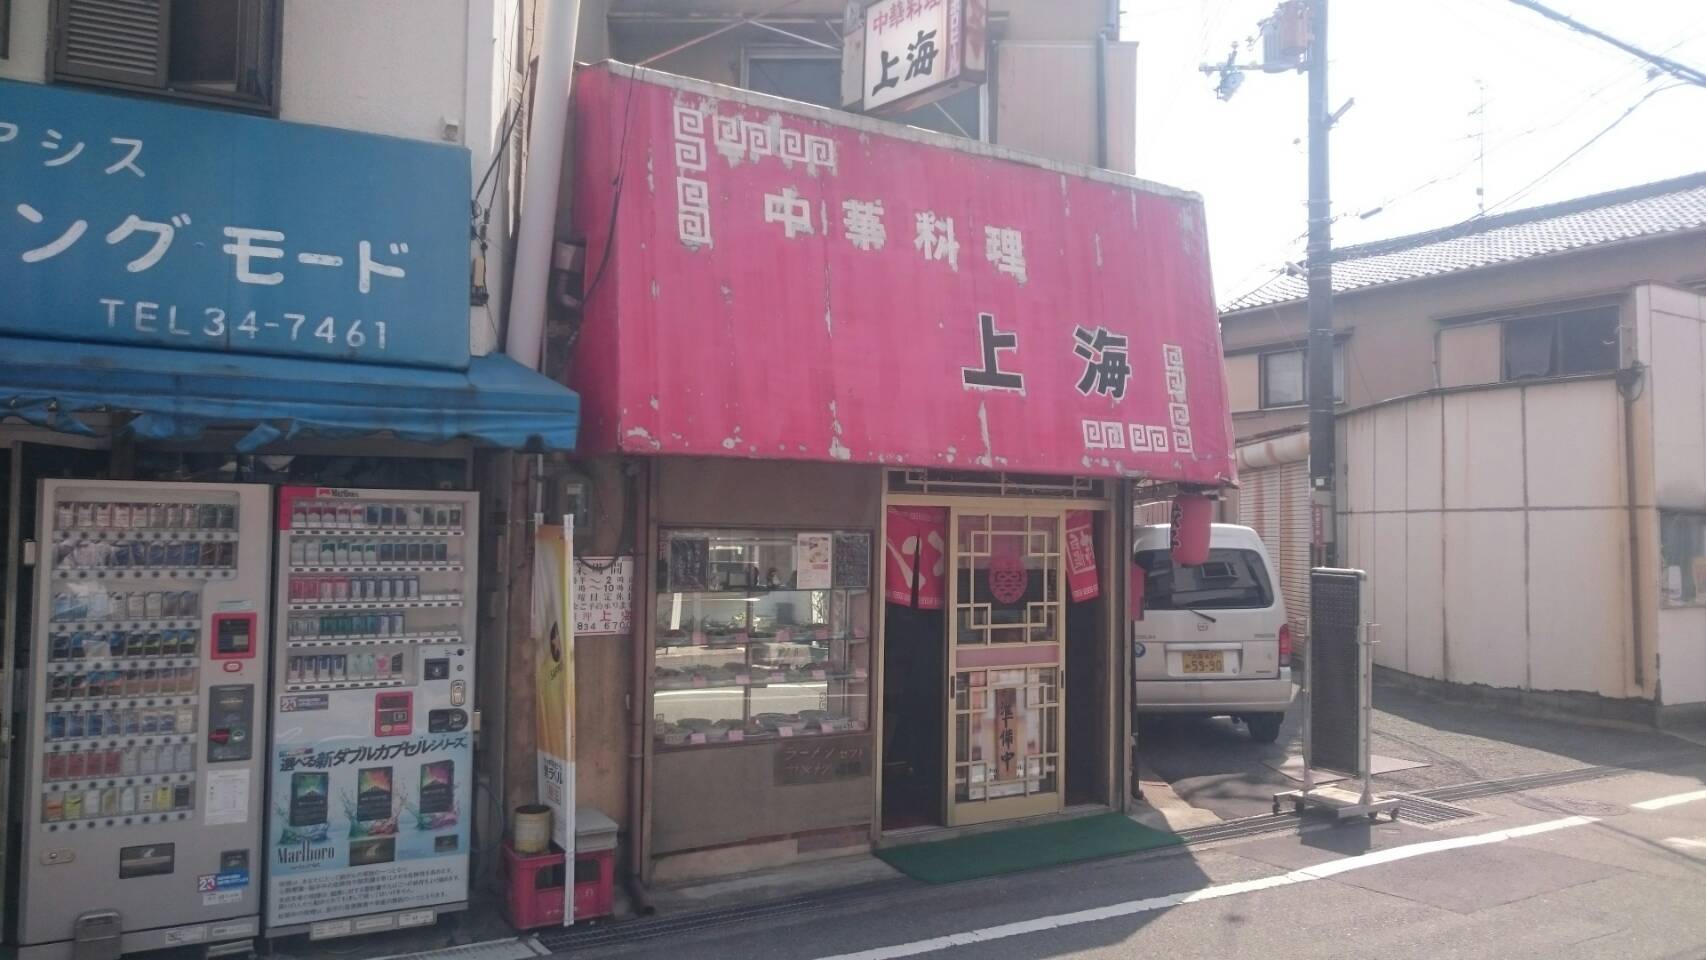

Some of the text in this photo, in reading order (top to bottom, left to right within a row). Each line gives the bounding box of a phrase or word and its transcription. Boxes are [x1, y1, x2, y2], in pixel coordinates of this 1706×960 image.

[871, 29, 940, 97] 上海
[763, 186, 1029, 283] 中華料理
[961, 312, 1132, 400] 上海
[1000, 702, 1015, 772] 準備中
[277, 838, 335, 864] Marlboro
